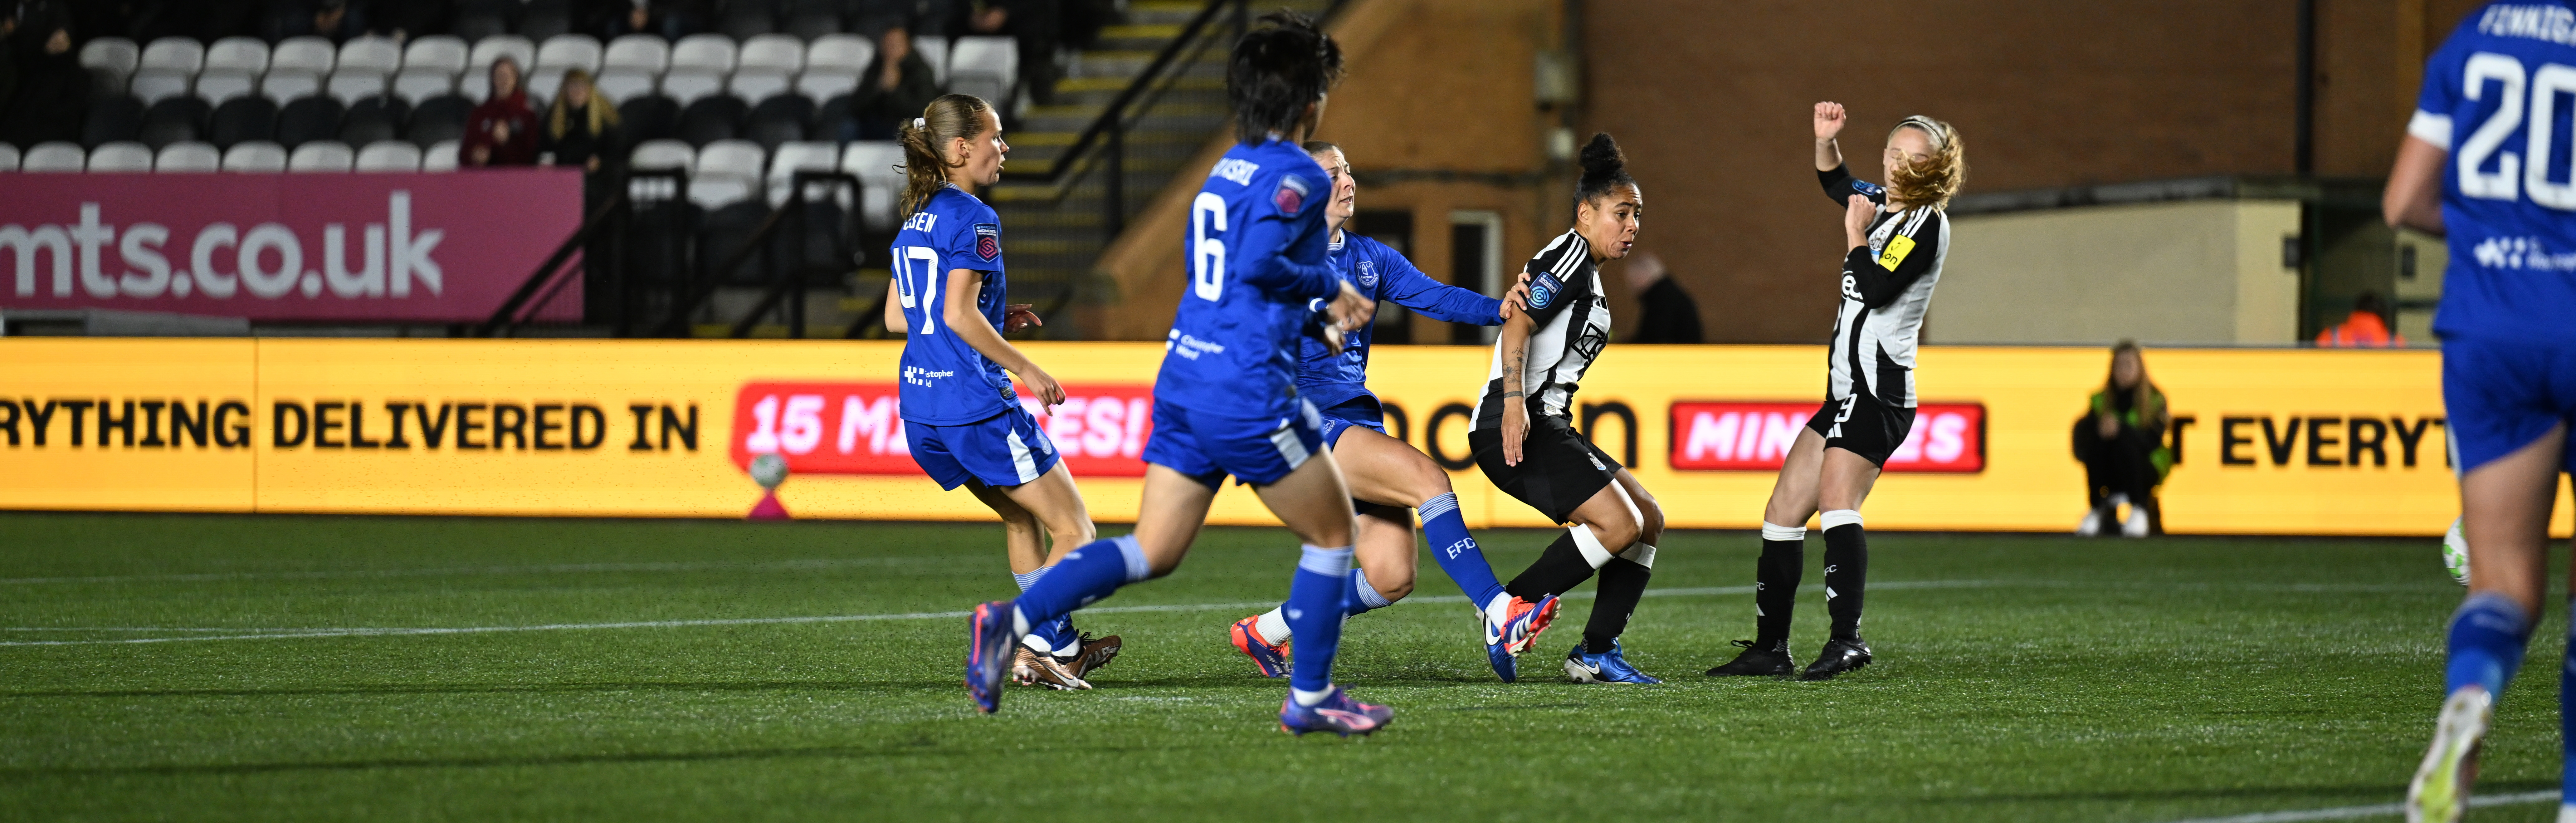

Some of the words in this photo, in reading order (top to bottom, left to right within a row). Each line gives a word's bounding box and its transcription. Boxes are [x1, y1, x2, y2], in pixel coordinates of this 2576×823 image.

[2458, 51, 2576, 212] 20
[0, 190, 444, 299] mts.co.uk
[1193, 191, 1227, 302] 6
[1540, 277, 1557, 292] WOMEN'S
[1546, 277, 1559, 289] BARCLAYS
[0, 399, 251, 449] RYTHING
[273, 401, 607, 450] DELIVERED
[630, 404, 698, 450] IN
[746, 394, 826, 455] 15
[1834, 393, 1858, 423] 9
[1446, 537, 1476, 560] EFC
